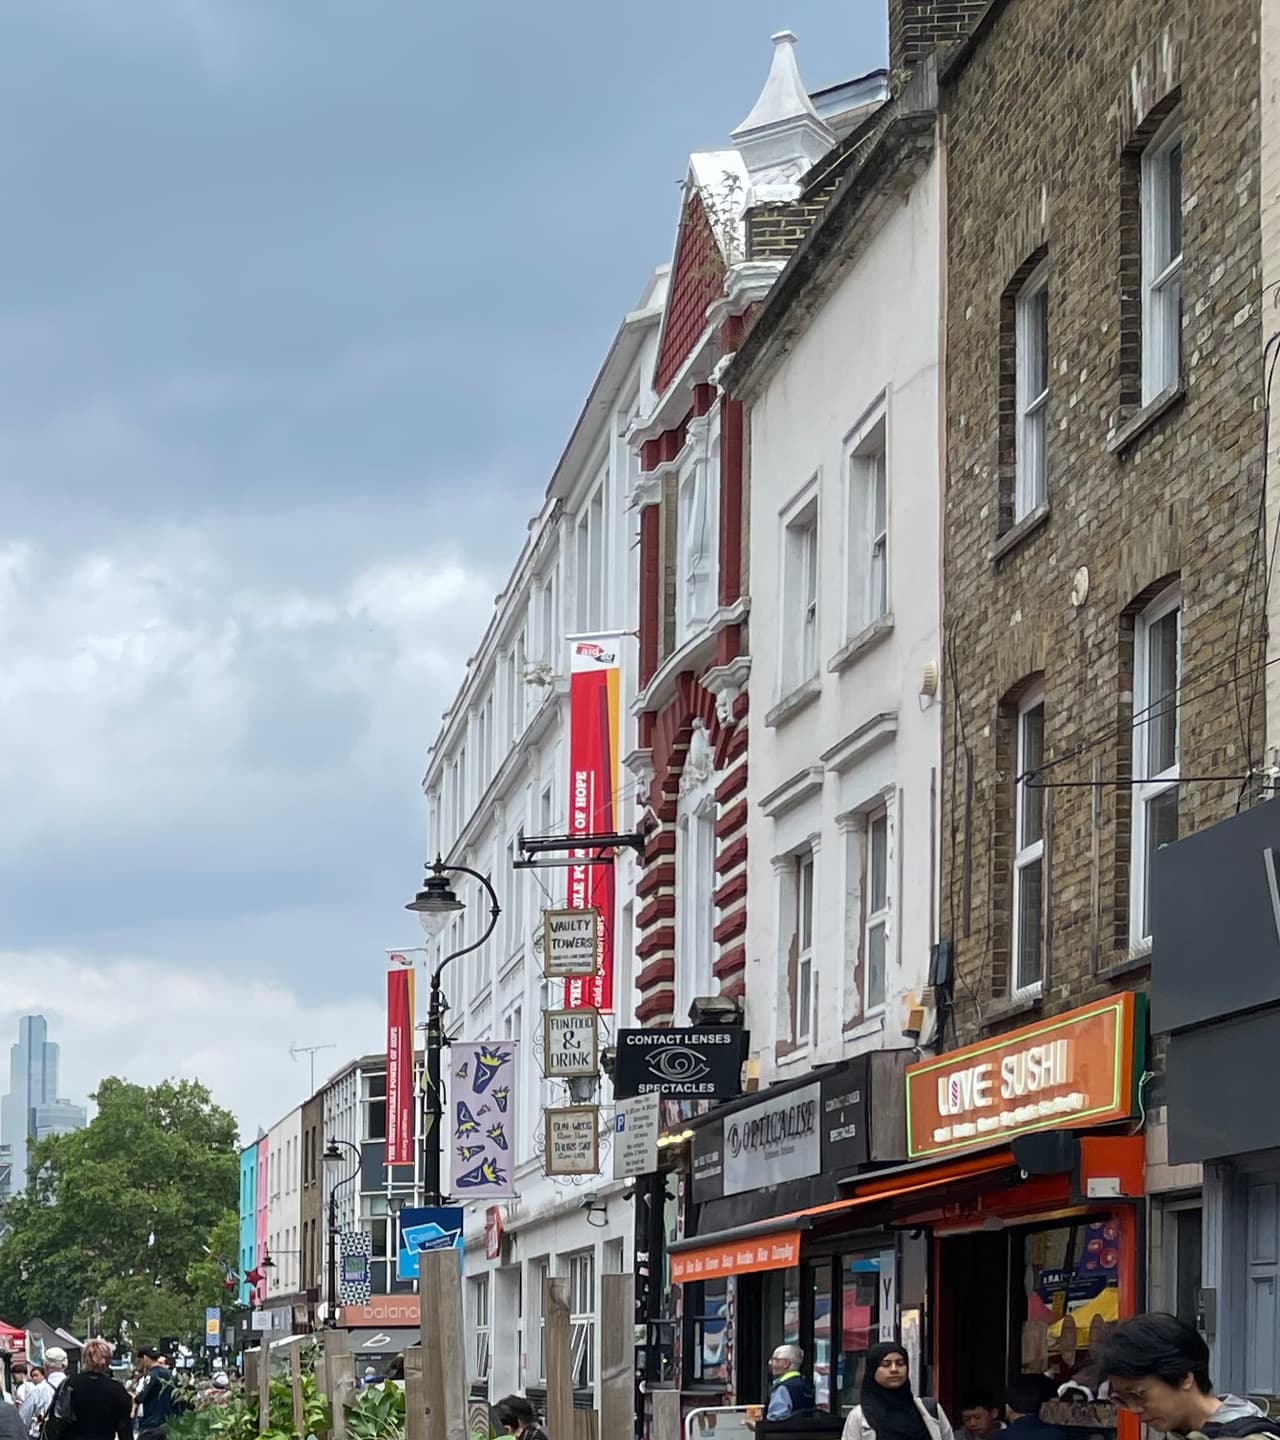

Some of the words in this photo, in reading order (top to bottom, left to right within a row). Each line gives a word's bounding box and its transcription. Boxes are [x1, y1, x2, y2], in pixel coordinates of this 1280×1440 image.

[574, 771, 587, 808] HOPE
[574, 809, 587, 829] OF
[550, 920, 591, 932] VAULTY
[551, 937, 593, 949] TOWERS
[562, 1030, 581, 1050] &
[626, 1034, 683, 1045] CONTACT
[684, 1034, 732, 1045] LENSES
[550, 1052, 591, 1068] DRINK
[937, 1063, 992, 1117] LOVE
[1001, 1038, 1073, 1100] SUSHI
[638, 1083, 715, 1094] SPECTACLES
[617, 1115, 625, 1132] P
[364, 1304, 420, 1320] balanc
